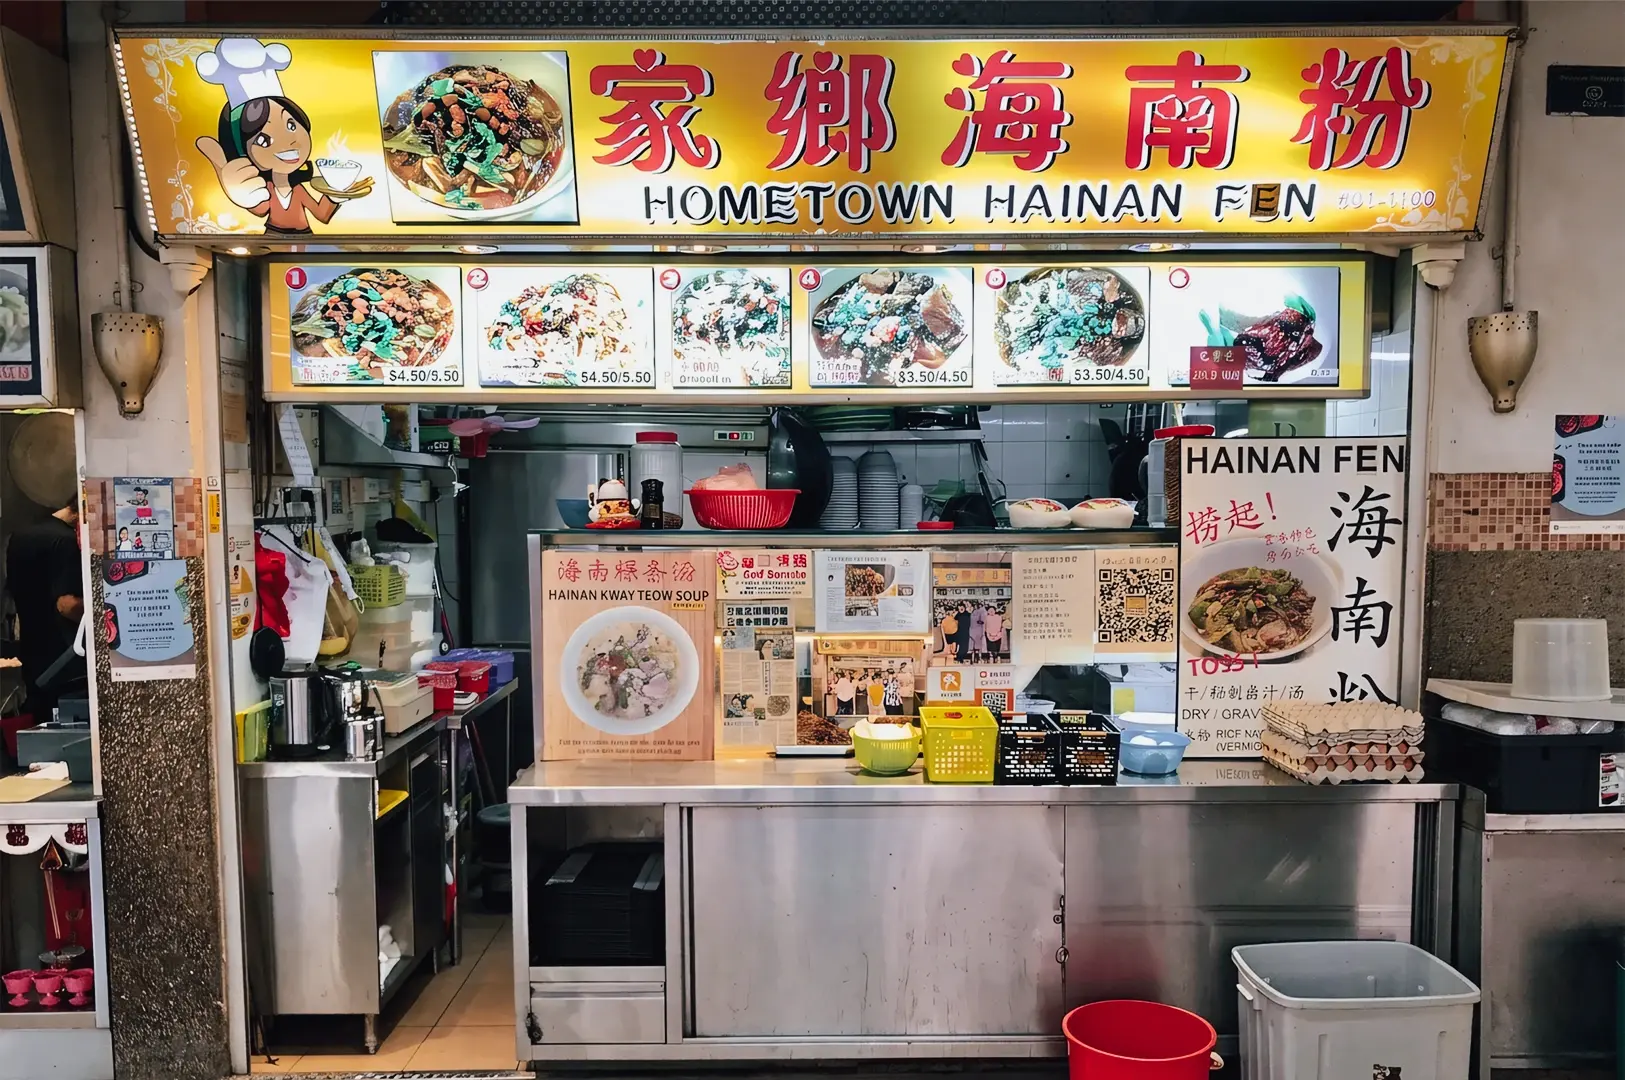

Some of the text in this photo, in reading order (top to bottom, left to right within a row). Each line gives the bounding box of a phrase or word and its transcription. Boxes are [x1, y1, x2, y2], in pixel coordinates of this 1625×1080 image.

[590, 47, 1431, 173] 家鄉海南粉
[644, 183, 954, 226] HOMETOWN
[984, 182, 1183, 224] HAINAN
[1214, 182, 1318, 223] FEN
[1187, 444, 1404, 474] HAINAN FEN
[549, 589, 709, 602] HAINAN KWAY TEOW SOUP
[1182, 708, 1210, 720] DRY
[1221, 708, 1262, 720] GRAV
